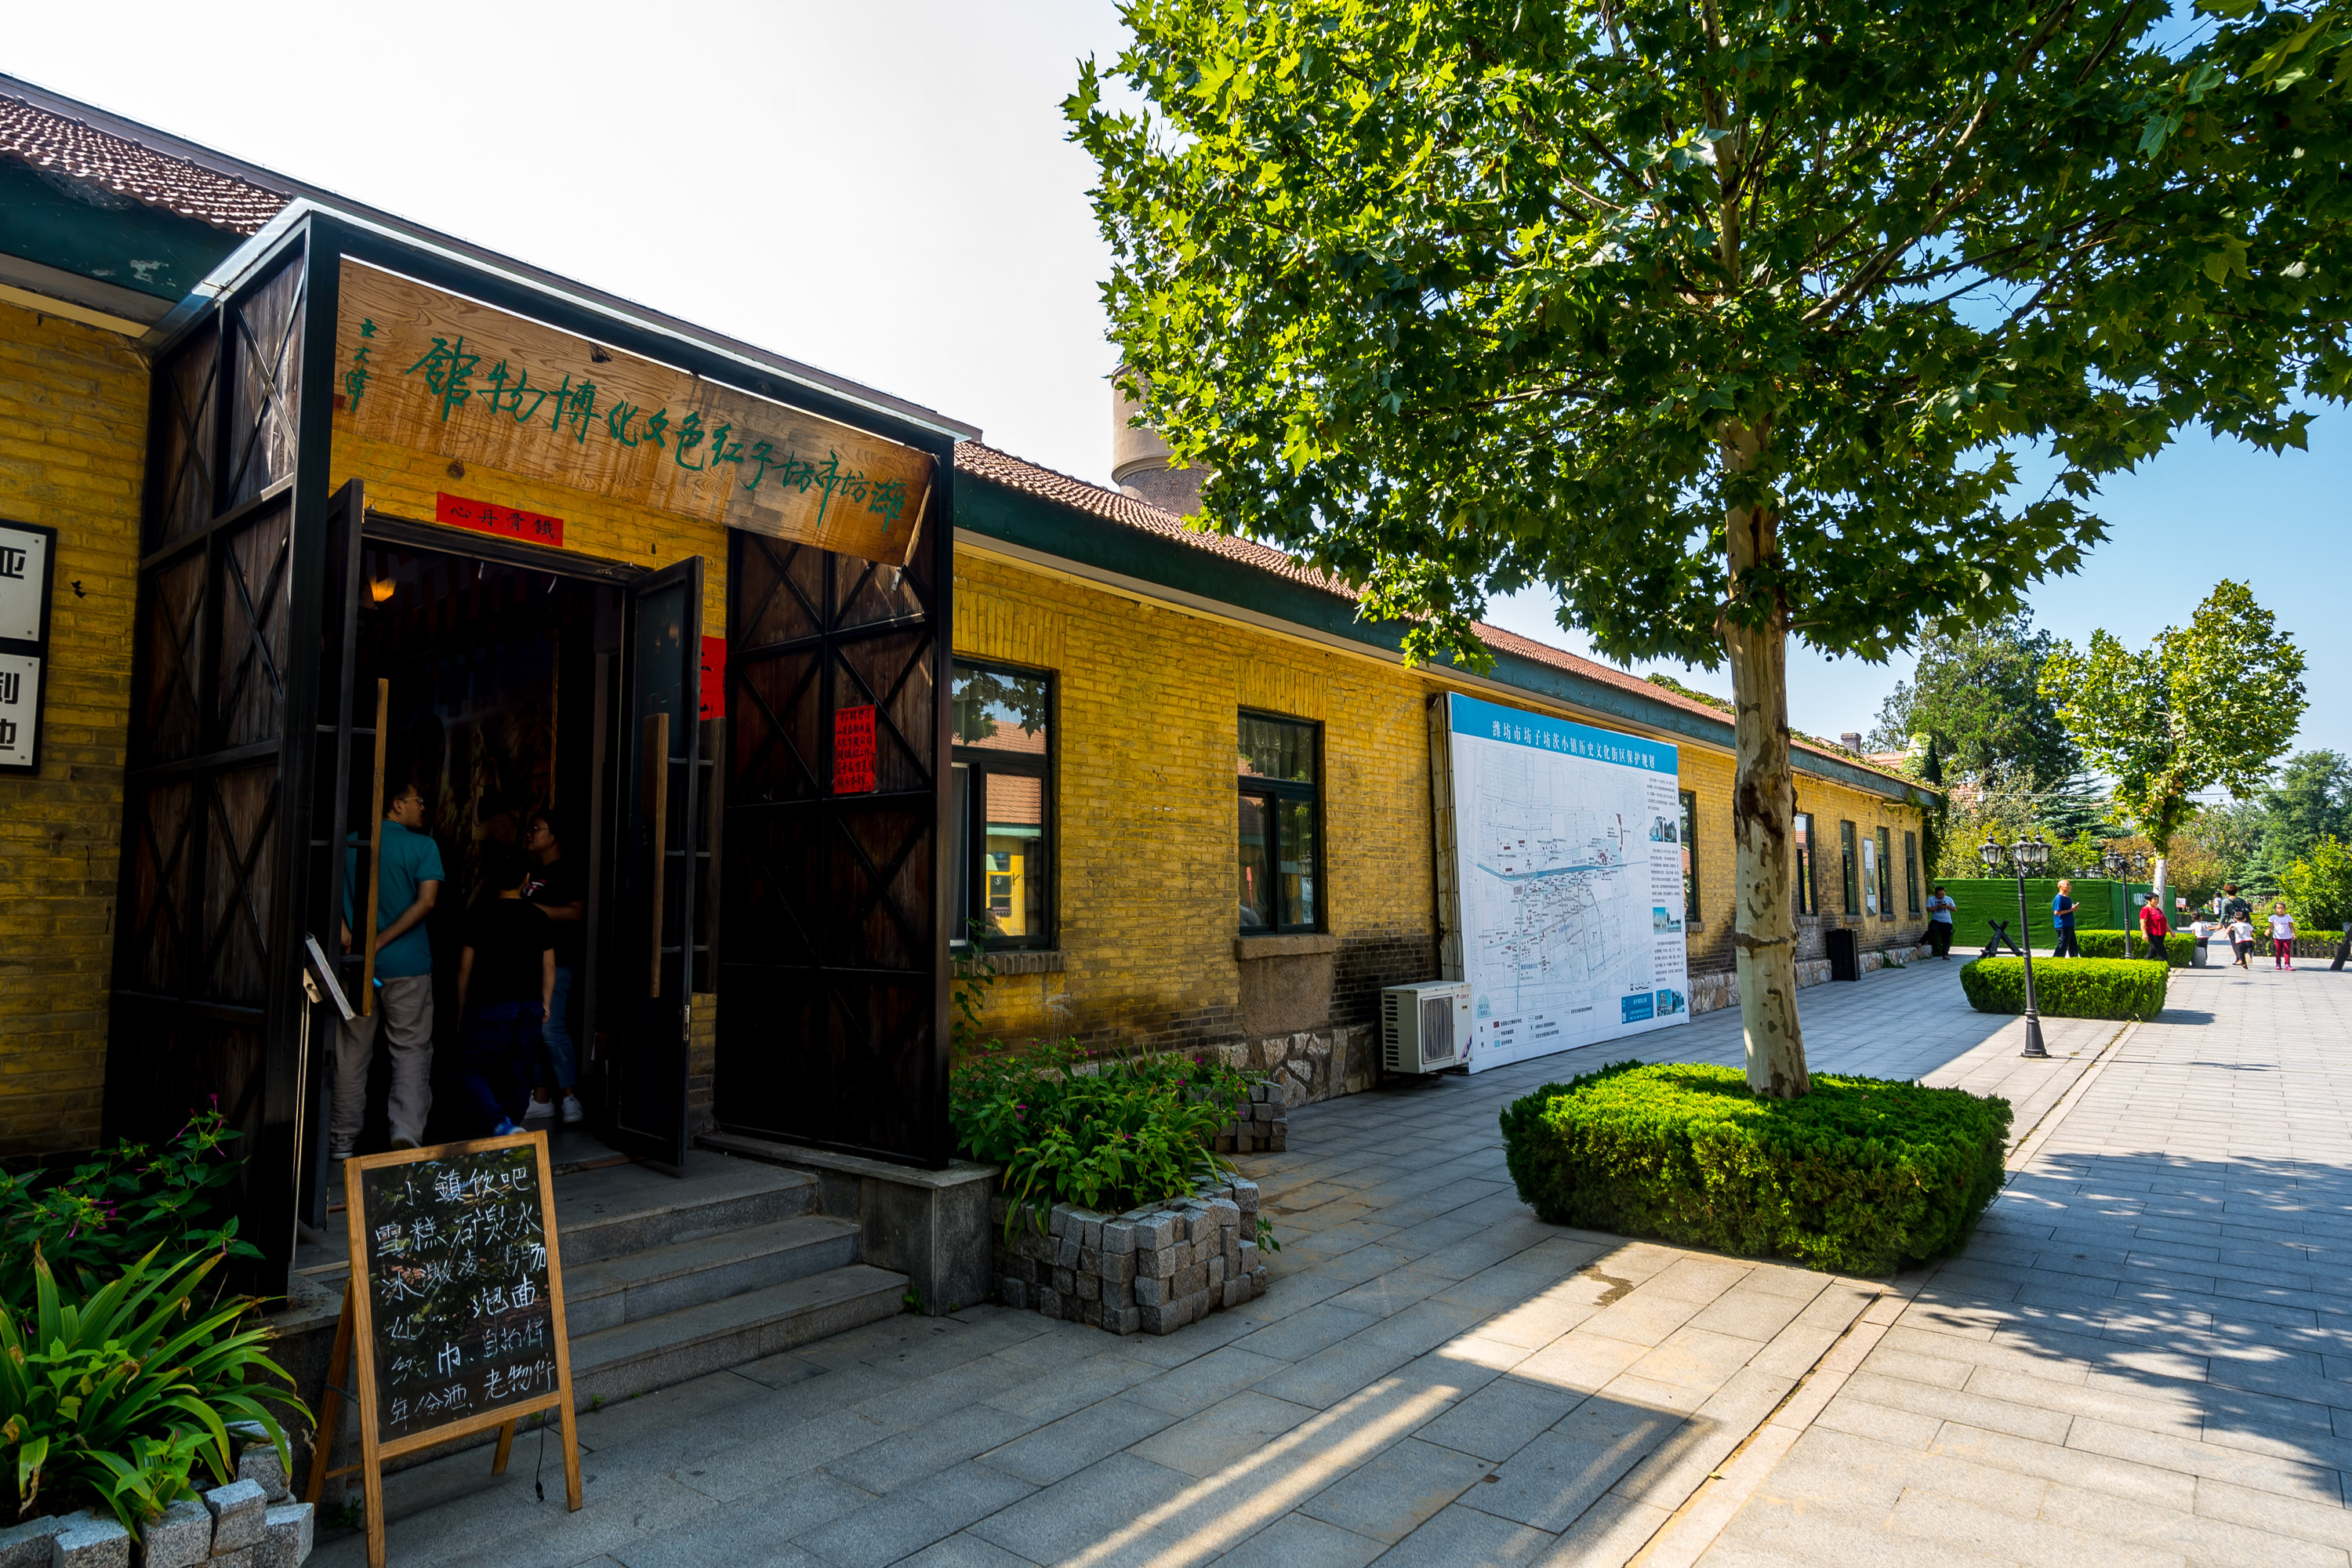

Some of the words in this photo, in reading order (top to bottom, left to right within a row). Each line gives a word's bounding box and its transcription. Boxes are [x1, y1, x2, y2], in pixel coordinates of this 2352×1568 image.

[1492, 720, 1655, 769] 潍坊市坊子坊茨小镇历史文化街区保护规划
